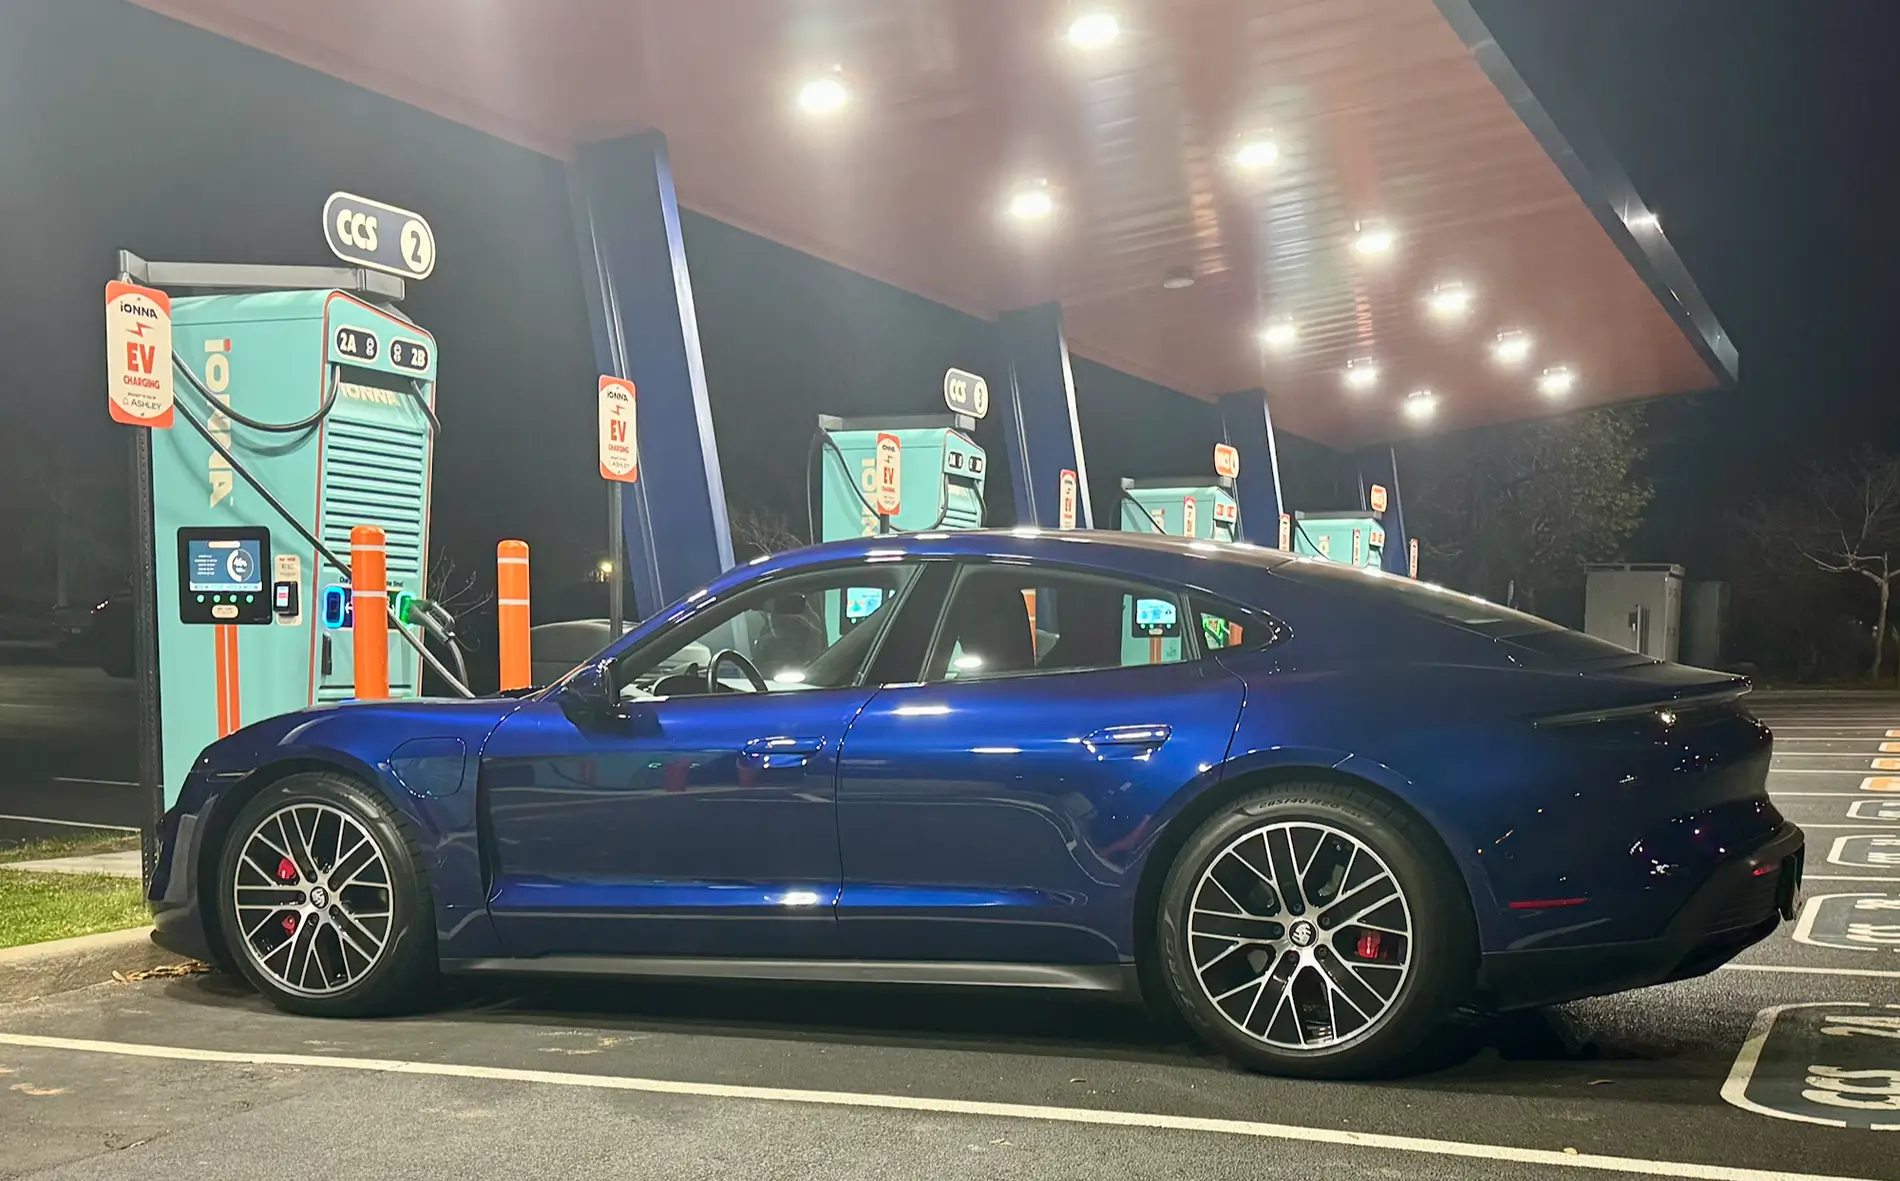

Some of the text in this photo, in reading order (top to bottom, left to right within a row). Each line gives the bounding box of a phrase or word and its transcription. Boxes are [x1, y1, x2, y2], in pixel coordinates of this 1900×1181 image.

[337, 209, 422, 264] CCS 2
[120, 300, 158, 319] iONNA
[340, 332, 356, 353] 2A
[126, 341, 155, 374] EV
[411, 348, 426, 367] 2B
[123, 375, 160, 389] CHARGING
[949, 378, 966, 403] CCS
[131, 398, 162, 411] ASHLEY
[610, 419, 626, 443] EV
[883, 466, 894, 485] EV
